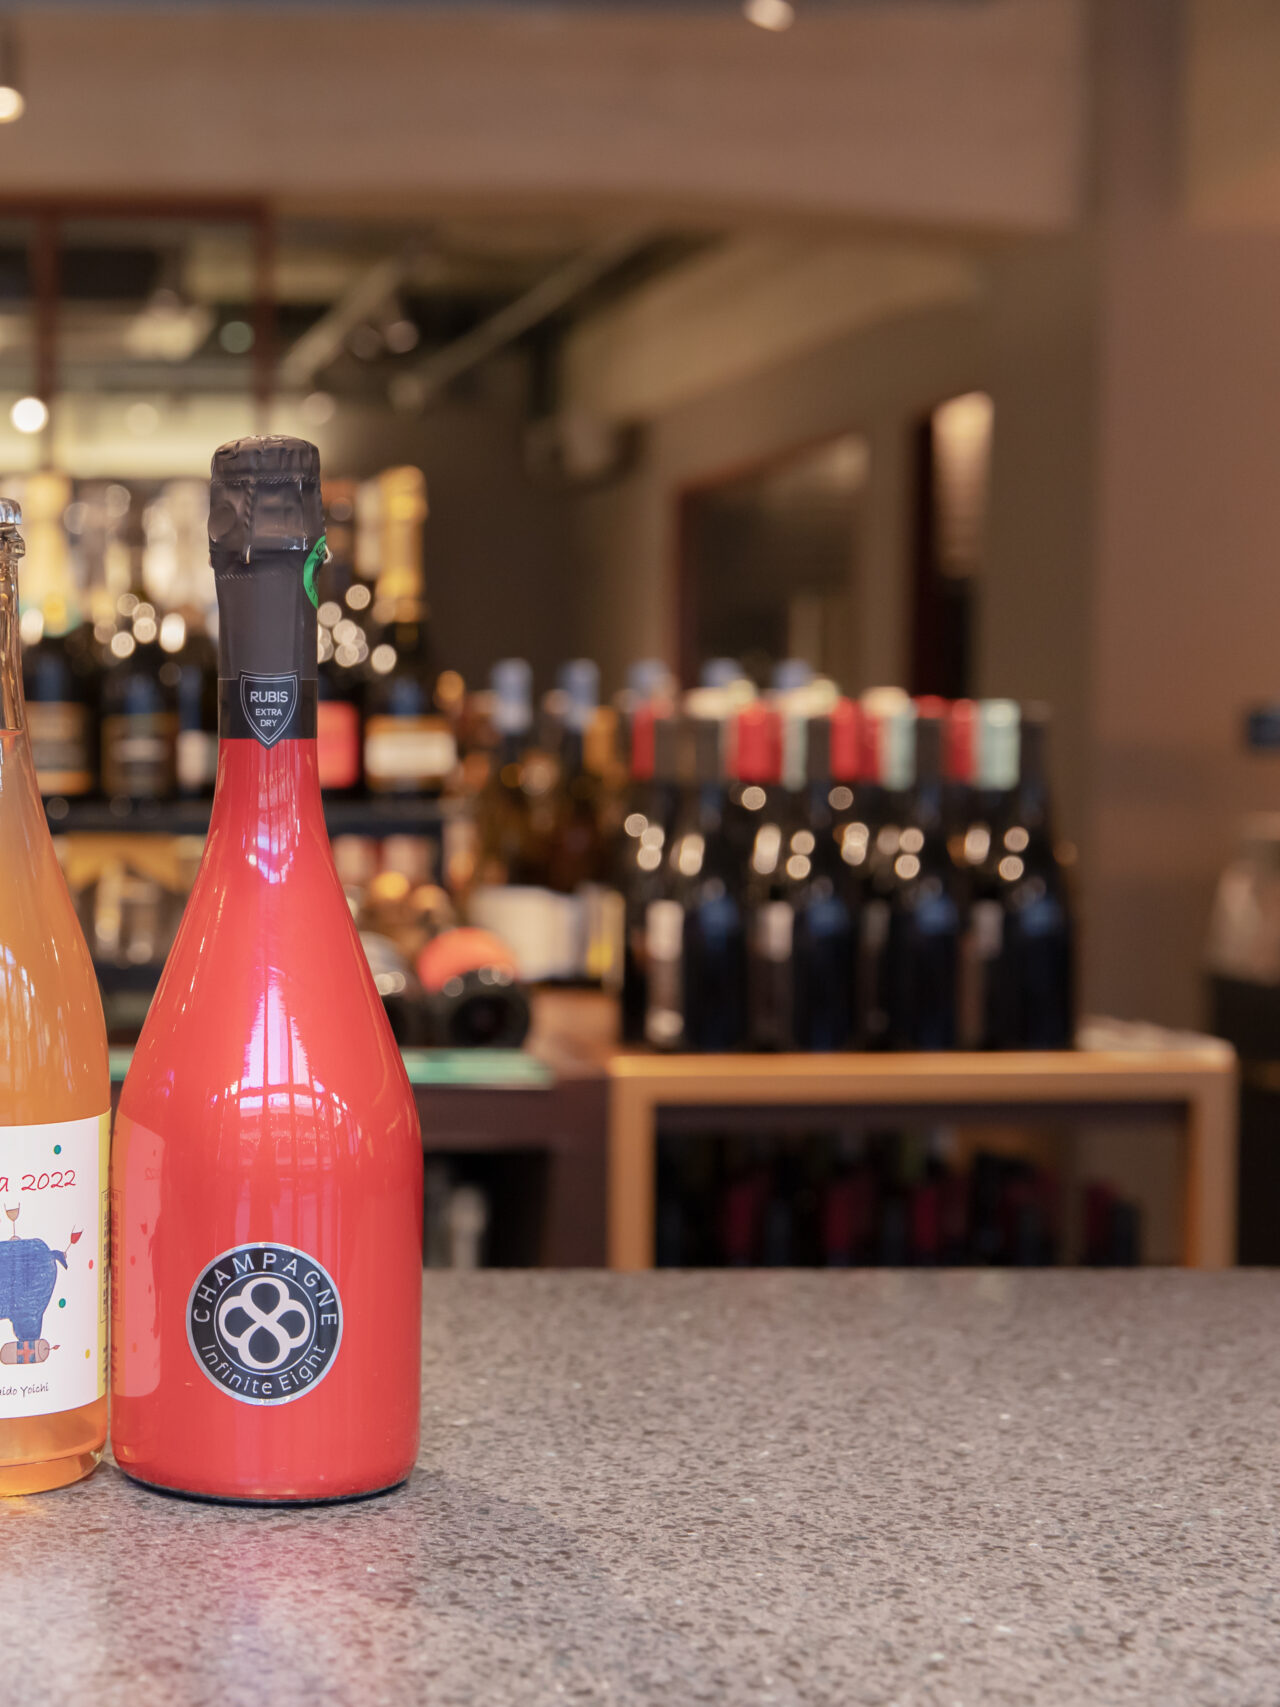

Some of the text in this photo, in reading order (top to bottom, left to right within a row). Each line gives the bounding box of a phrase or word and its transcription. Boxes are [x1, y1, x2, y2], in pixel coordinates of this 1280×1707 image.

[250, 691, 288, 703] RUBIS
[255, 708, 282, 716] EXTRA
[260, 719, 277, 727] DRY
[21, 1169, 77, 1191] 2022
[193, 1252, 337, 1326] CHAMPAGNE
[201, 1344, 327, 1395] Infinite Eight
[20, 1382, 49, 1398] Yoichi
